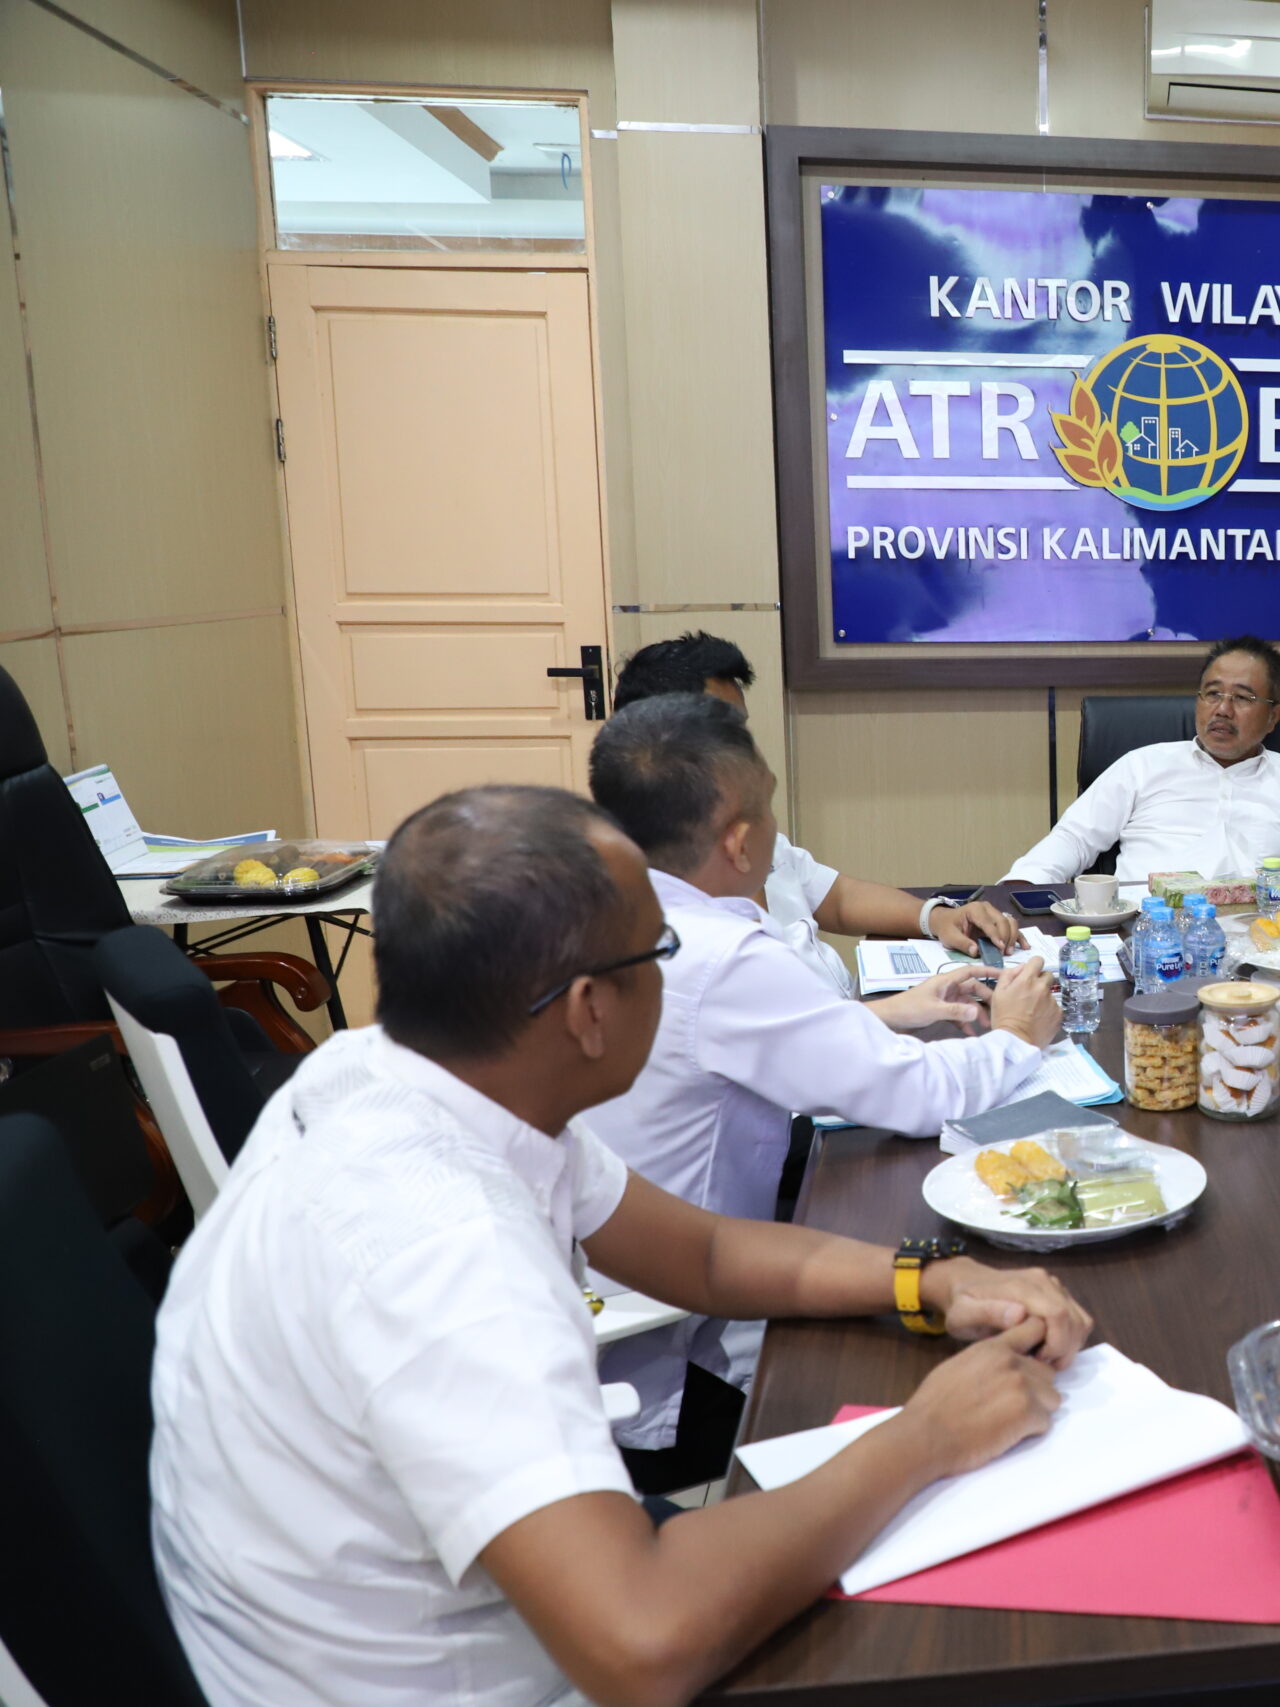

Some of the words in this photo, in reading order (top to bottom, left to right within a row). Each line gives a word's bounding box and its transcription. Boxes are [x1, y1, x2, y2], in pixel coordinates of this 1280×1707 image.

[929, 275, 1132, 322] KANTOR
[845, 380, 1040, 460] ATR
[847, 525, 1028, 561] PROVINSI
[1157, 963, 1174, 971] Pure
